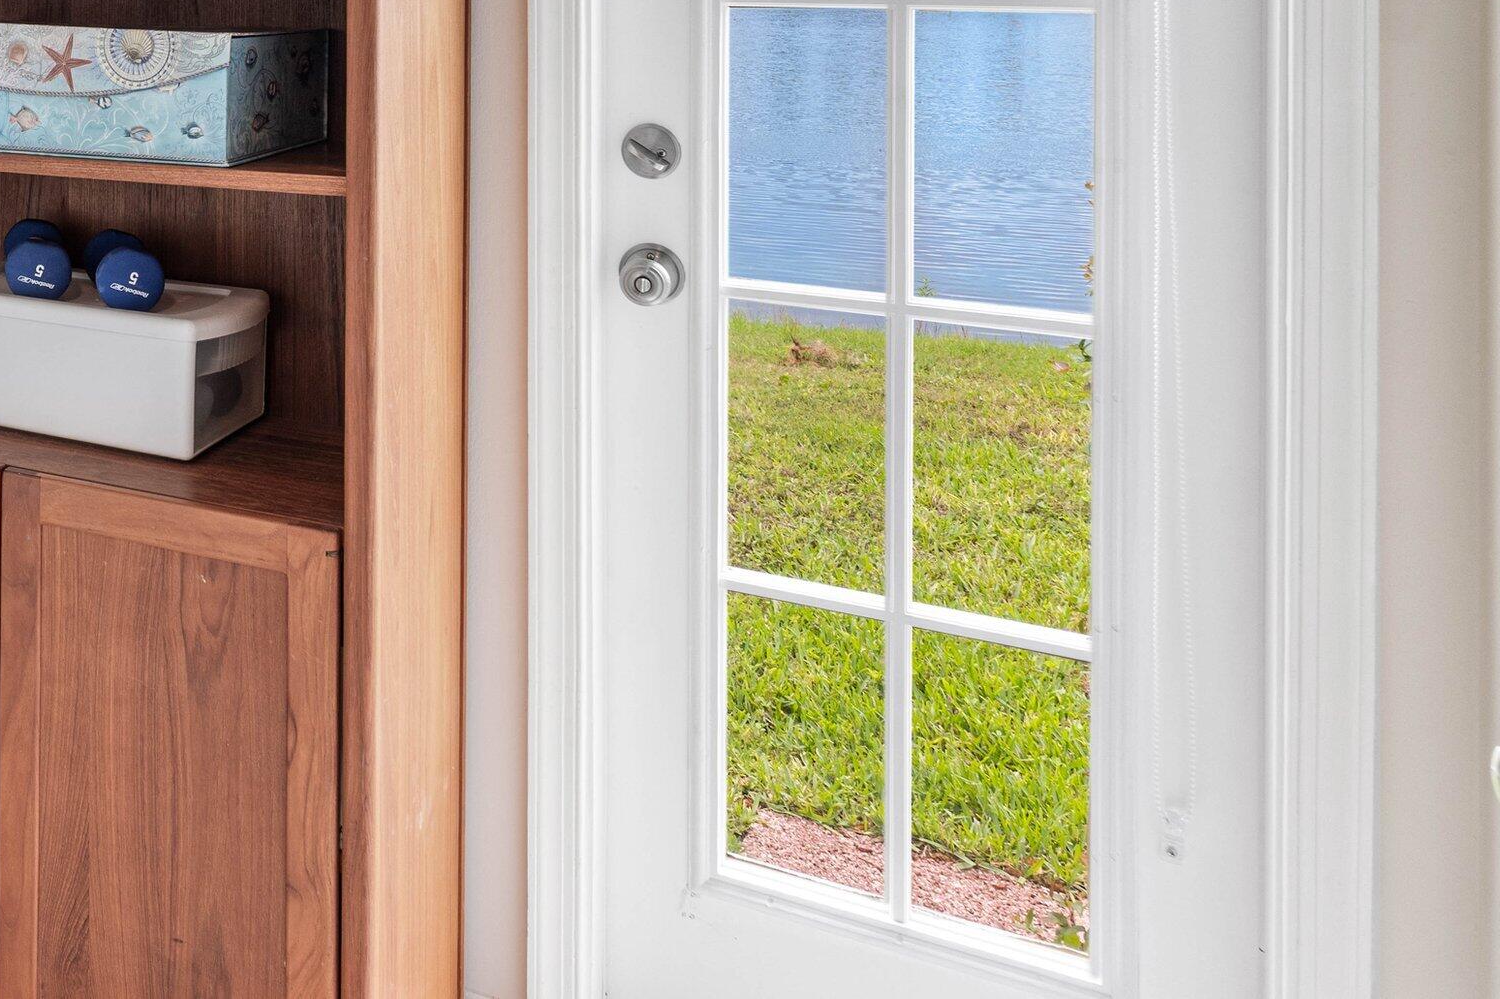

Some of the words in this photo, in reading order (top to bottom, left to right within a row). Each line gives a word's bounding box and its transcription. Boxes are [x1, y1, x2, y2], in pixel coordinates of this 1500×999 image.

[34, 264, 45, 278] 5
[128, 271, 139, 285] 5
[30, 279, 55, 290] Reebok
[123, 287, 149, 298] Reebok
